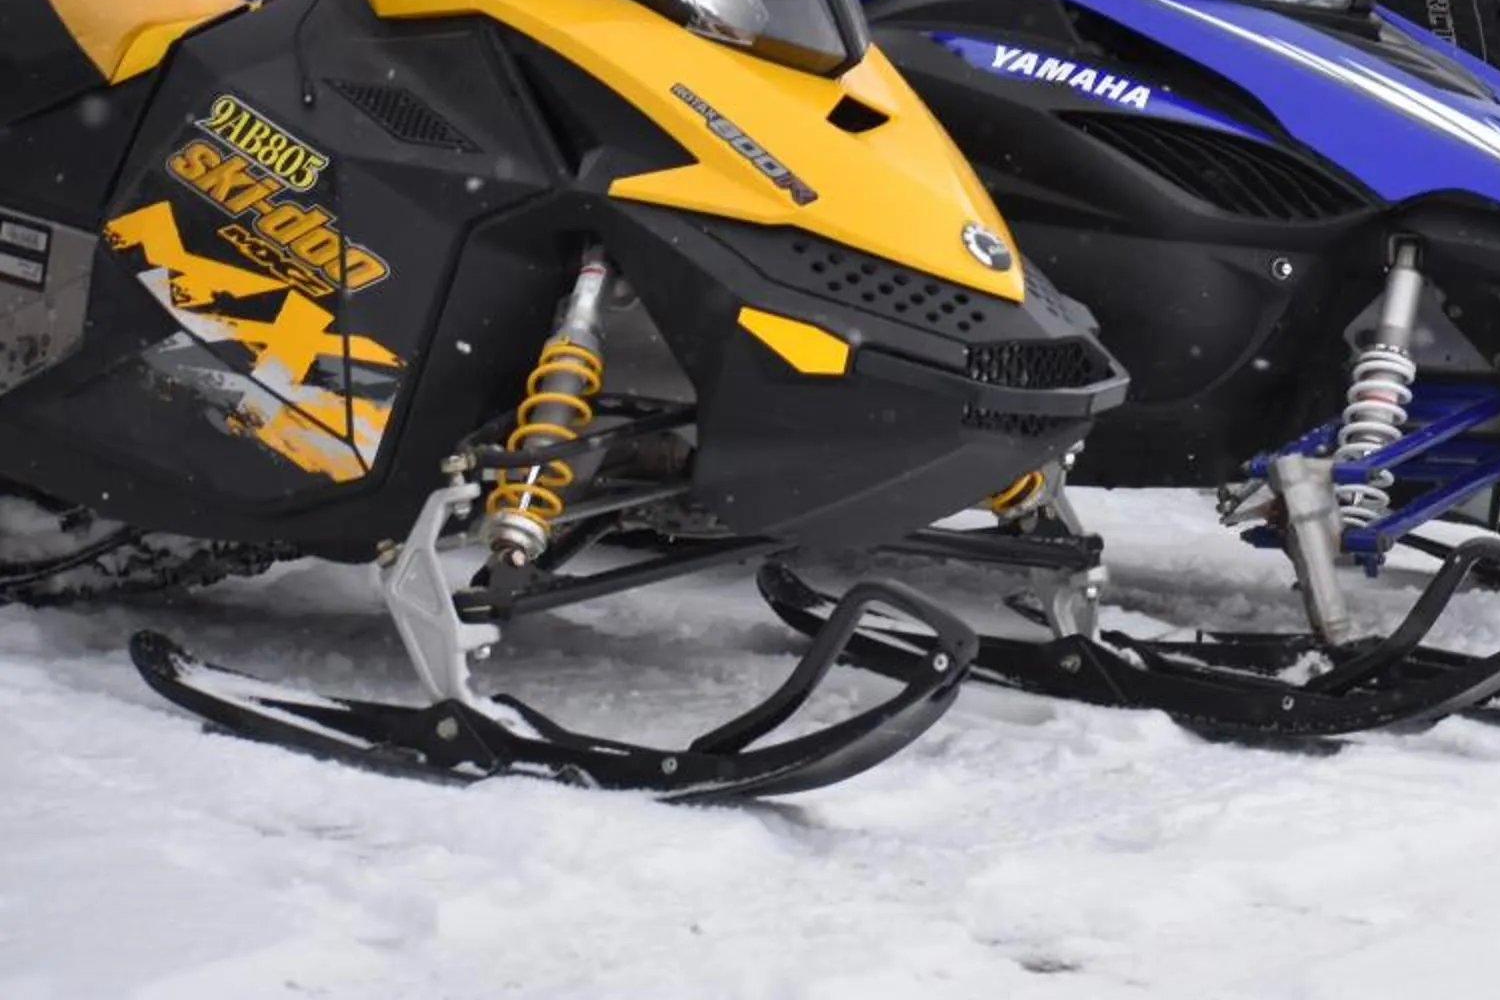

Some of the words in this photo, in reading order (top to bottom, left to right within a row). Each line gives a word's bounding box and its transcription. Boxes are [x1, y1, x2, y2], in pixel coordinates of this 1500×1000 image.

[991, 44, 1151, 110] YAMAHA
[202, 96, 327, 190] 9AB805
[706, 117, 819, 207] 800R
[166, 141, 391, 292] ski-doo
